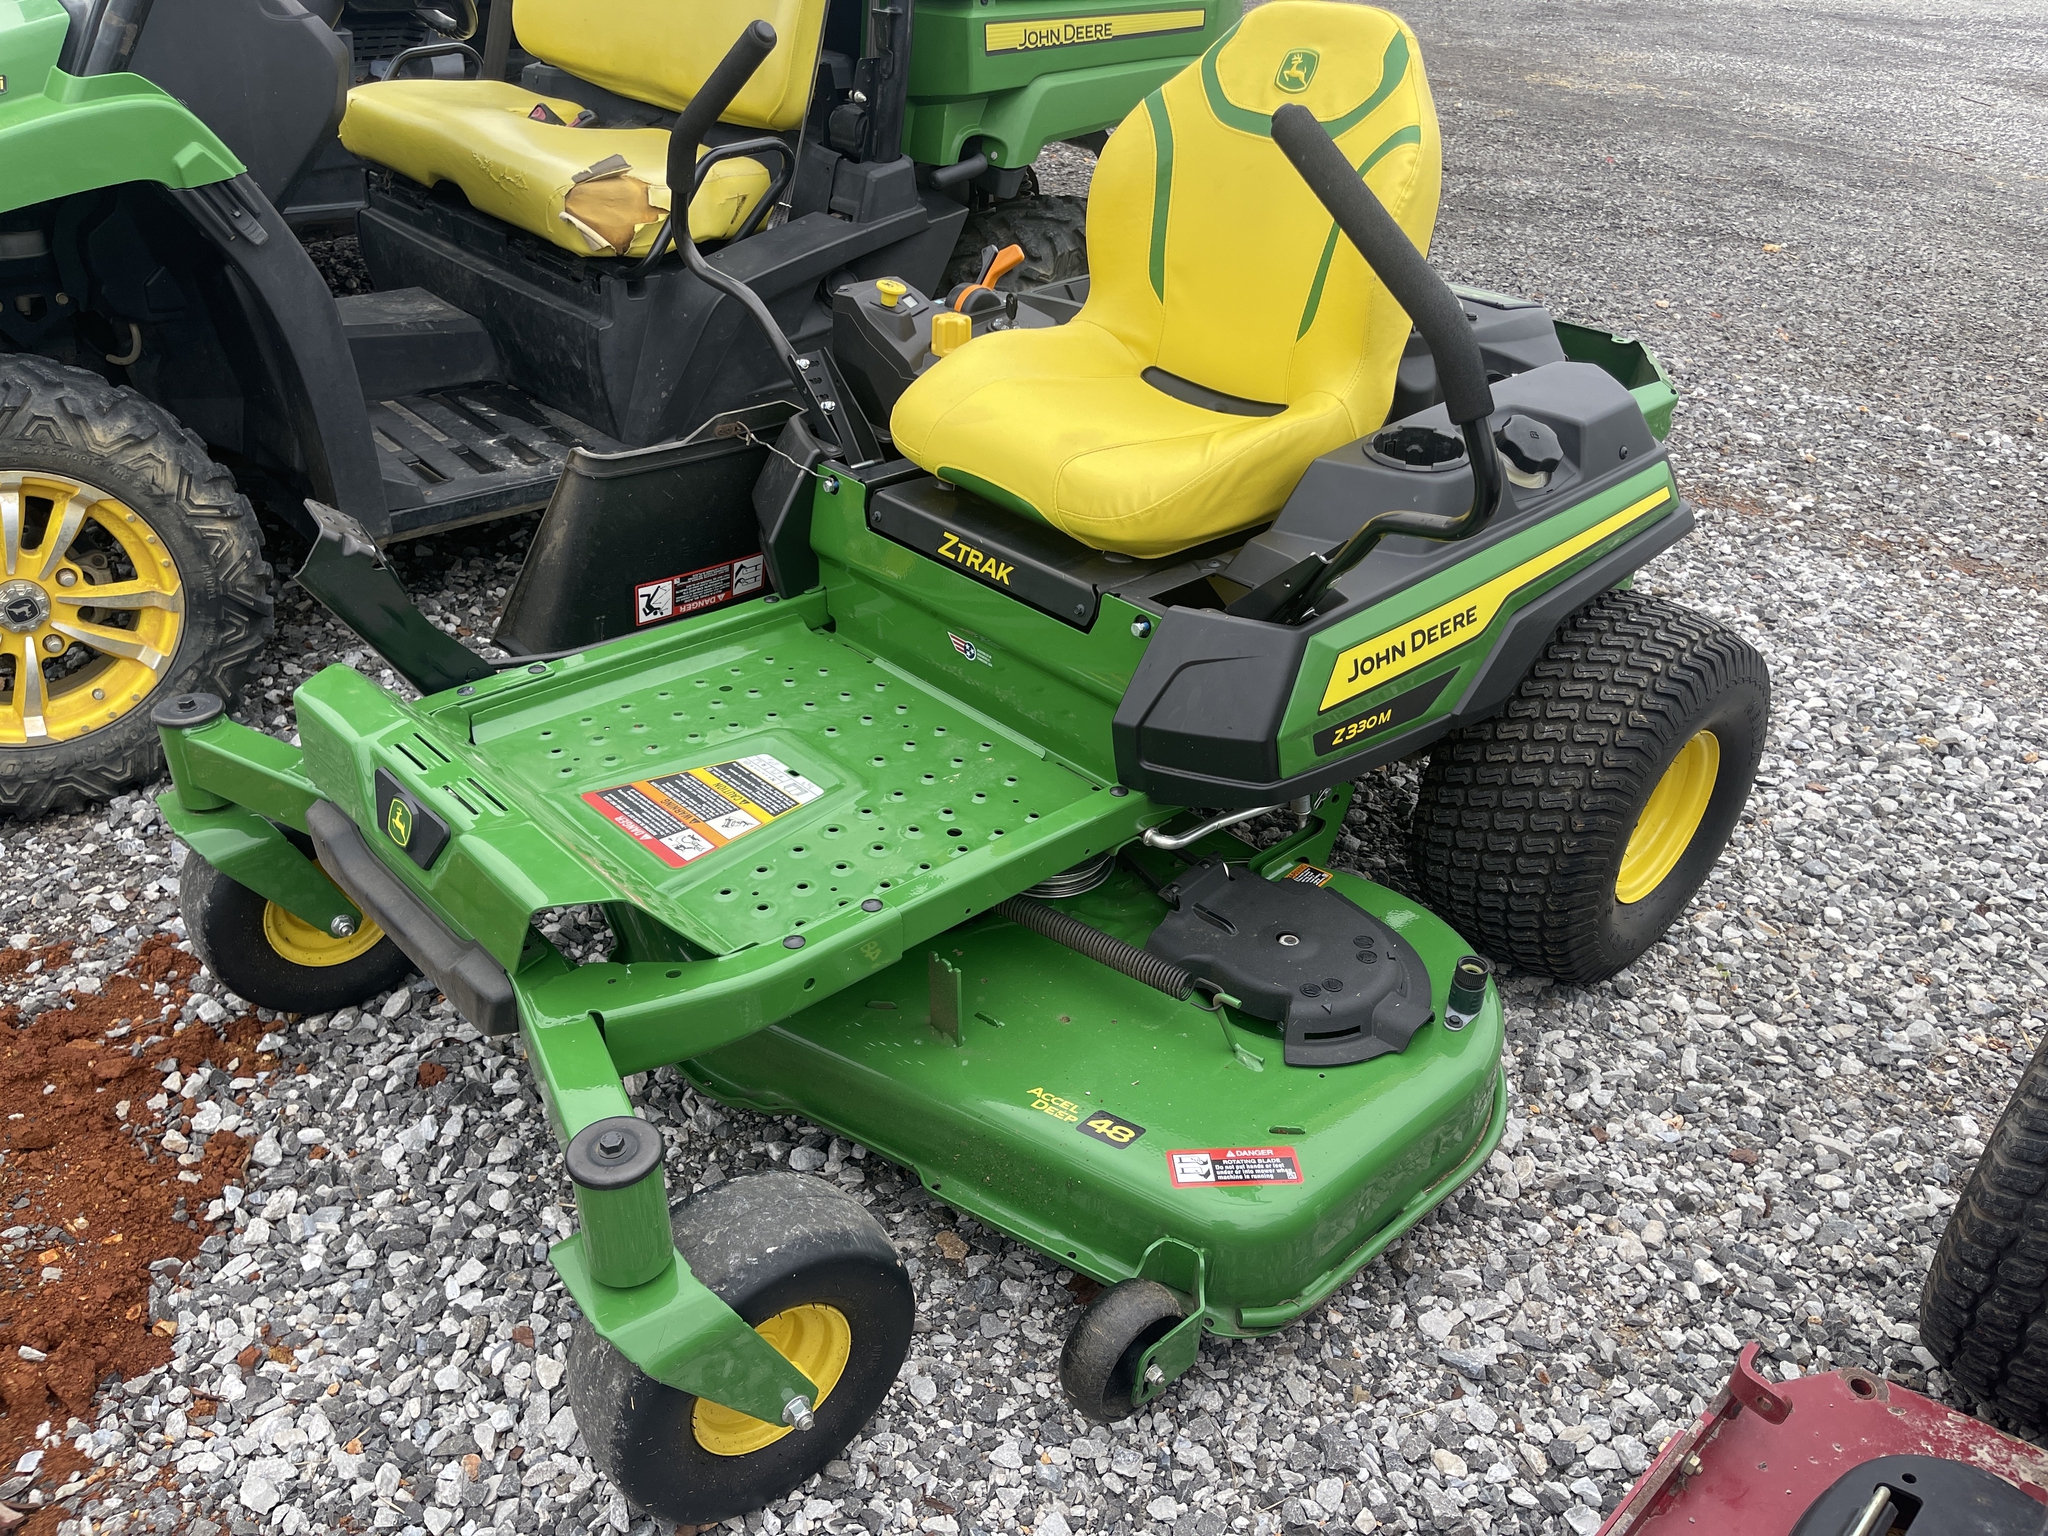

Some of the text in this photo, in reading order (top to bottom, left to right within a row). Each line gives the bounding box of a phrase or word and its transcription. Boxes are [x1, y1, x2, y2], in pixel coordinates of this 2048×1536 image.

[1019, 22, 1113, 48] JOHN DEERE
[937, 531, 1015, 586] ZTRAK
[679, 596, 717, 613] DANGER
[1347, 605, 1478, 684] JOHN DEERE
[1331, 708, 1393, 746] Z330M
[712, 781, 743, 801] CAUTION
[660, 798, 693, 821] WARNING
[614, 815, 645, 837] DANGER
[1025, 1087, 1079, 1114] ACCEL
[1030, 1098, 1079, 1122] DEEP
[1086, 1118, 1136, 1143] 48
[1235, 1149, 1274, 1157] DANGER
